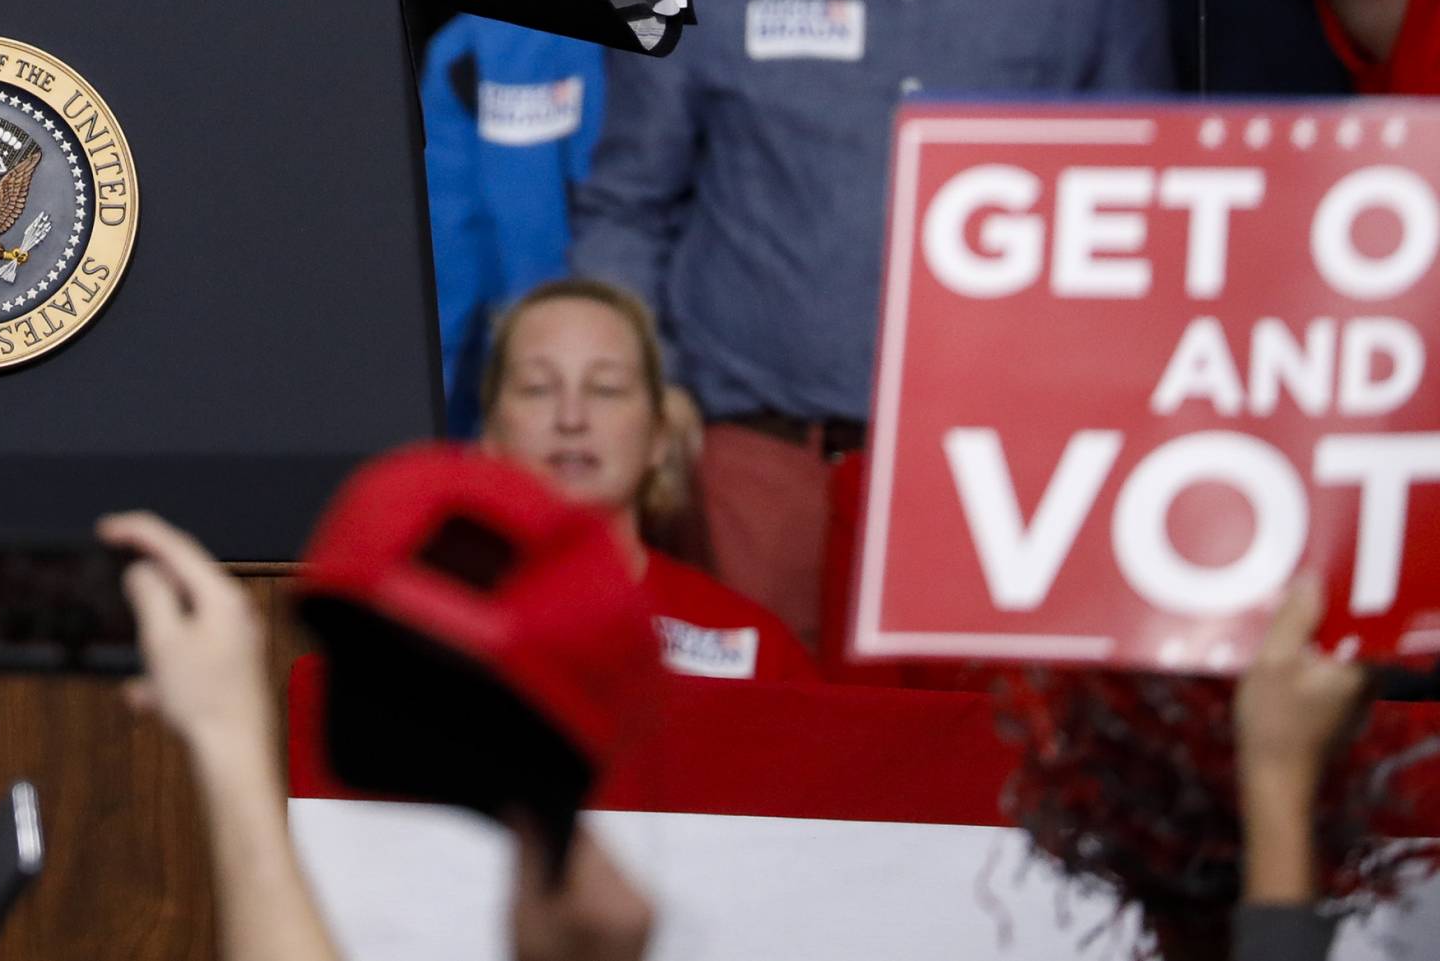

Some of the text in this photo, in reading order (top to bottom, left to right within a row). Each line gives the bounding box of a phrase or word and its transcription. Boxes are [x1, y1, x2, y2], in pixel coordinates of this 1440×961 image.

[15, 58, 57, 93] THE
[61, 89, 128, 227] UNITED
[922, 163, 1265, 300] GET
[1150, 315, 1426, 418] AND
